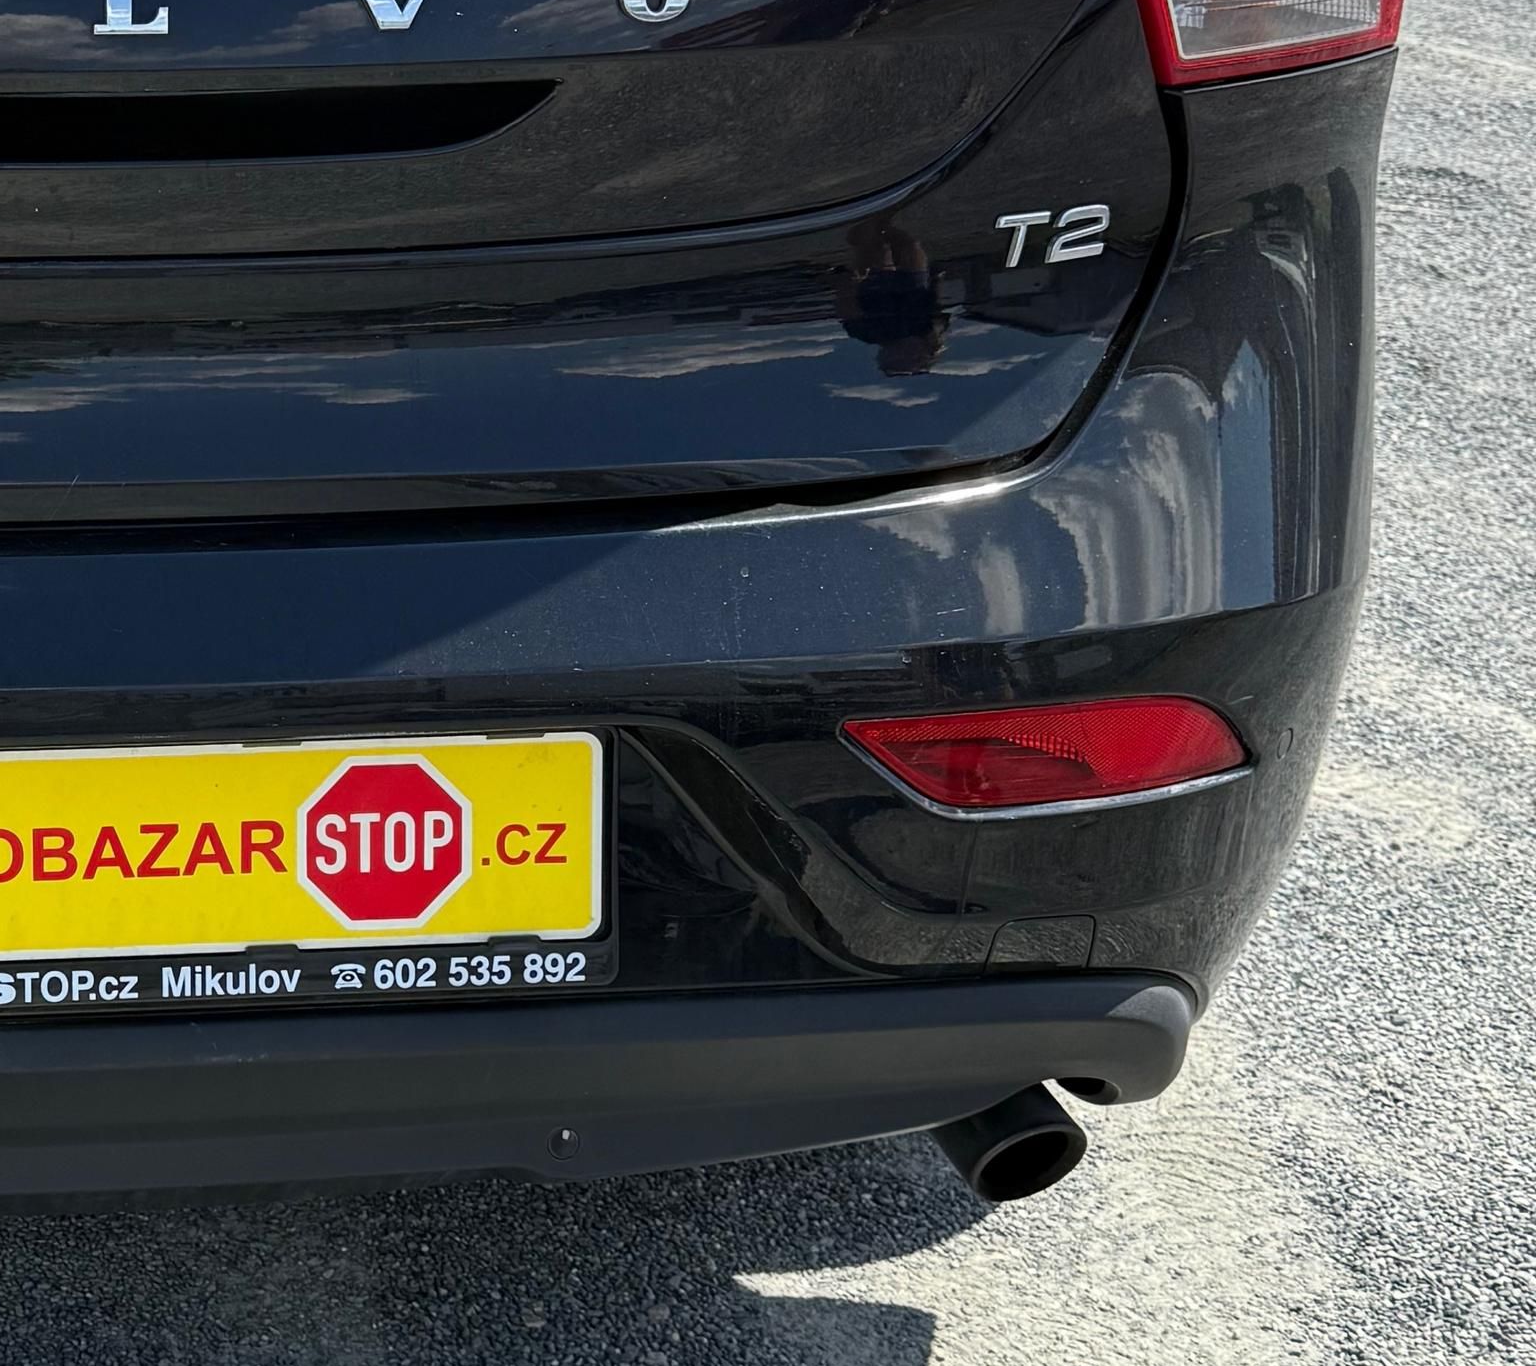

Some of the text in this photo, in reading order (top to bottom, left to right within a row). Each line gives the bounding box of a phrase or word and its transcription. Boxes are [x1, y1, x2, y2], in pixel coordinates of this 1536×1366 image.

[995, 204, 1110, 268] T2
[315, 810, 454, 875] STOP
[161, 963, 302, 998] Mikulov
[373, 957, 437, 990] 602
[448, 955, 511, 987] 535
[523, 951, 587, 985] 892
